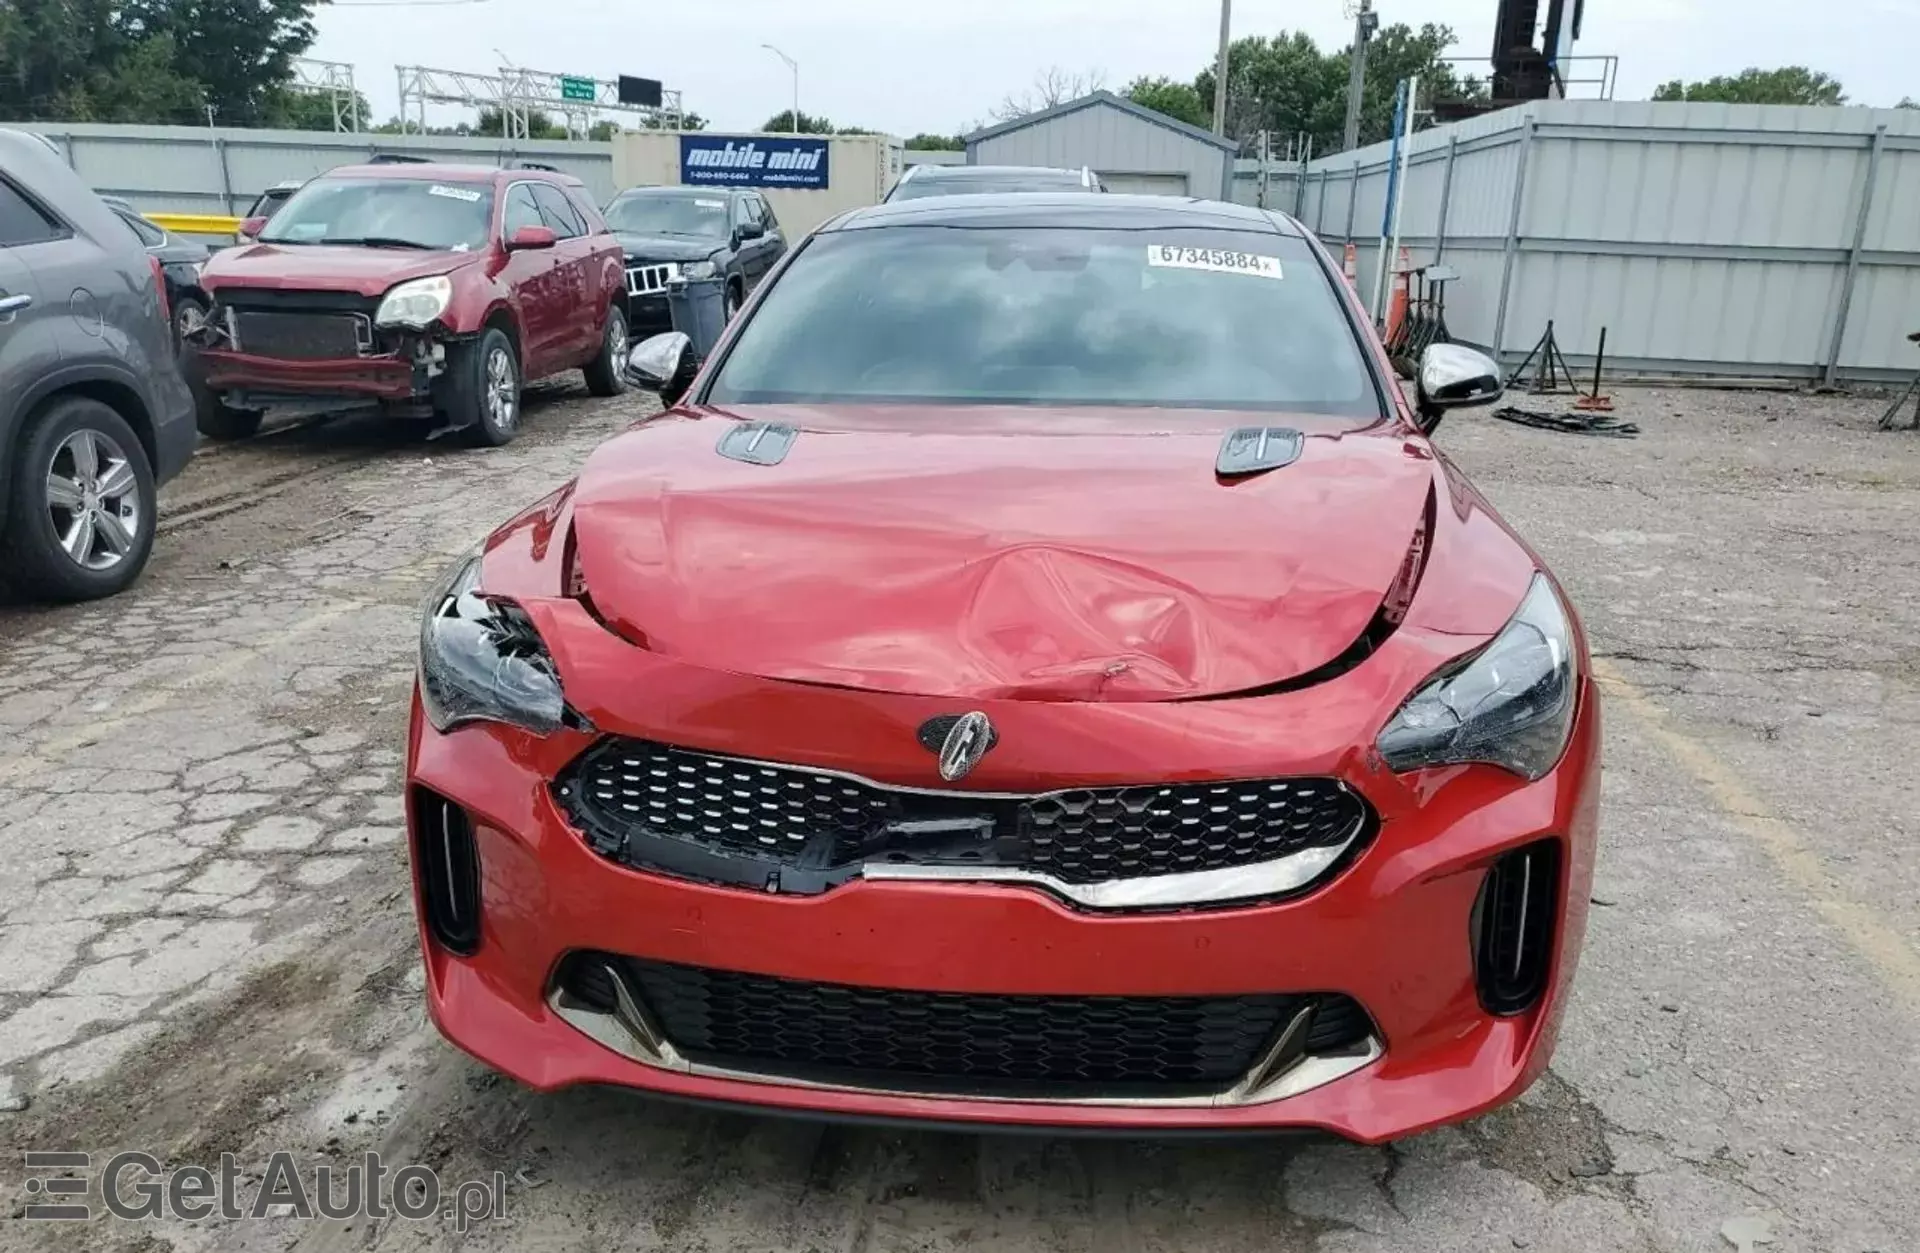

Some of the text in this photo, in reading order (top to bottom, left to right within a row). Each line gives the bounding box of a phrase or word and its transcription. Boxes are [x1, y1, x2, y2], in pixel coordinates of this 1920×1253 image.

[686, 141, 821, 170] mobile mini
[1160, 245, 1260, 270] 67345884
